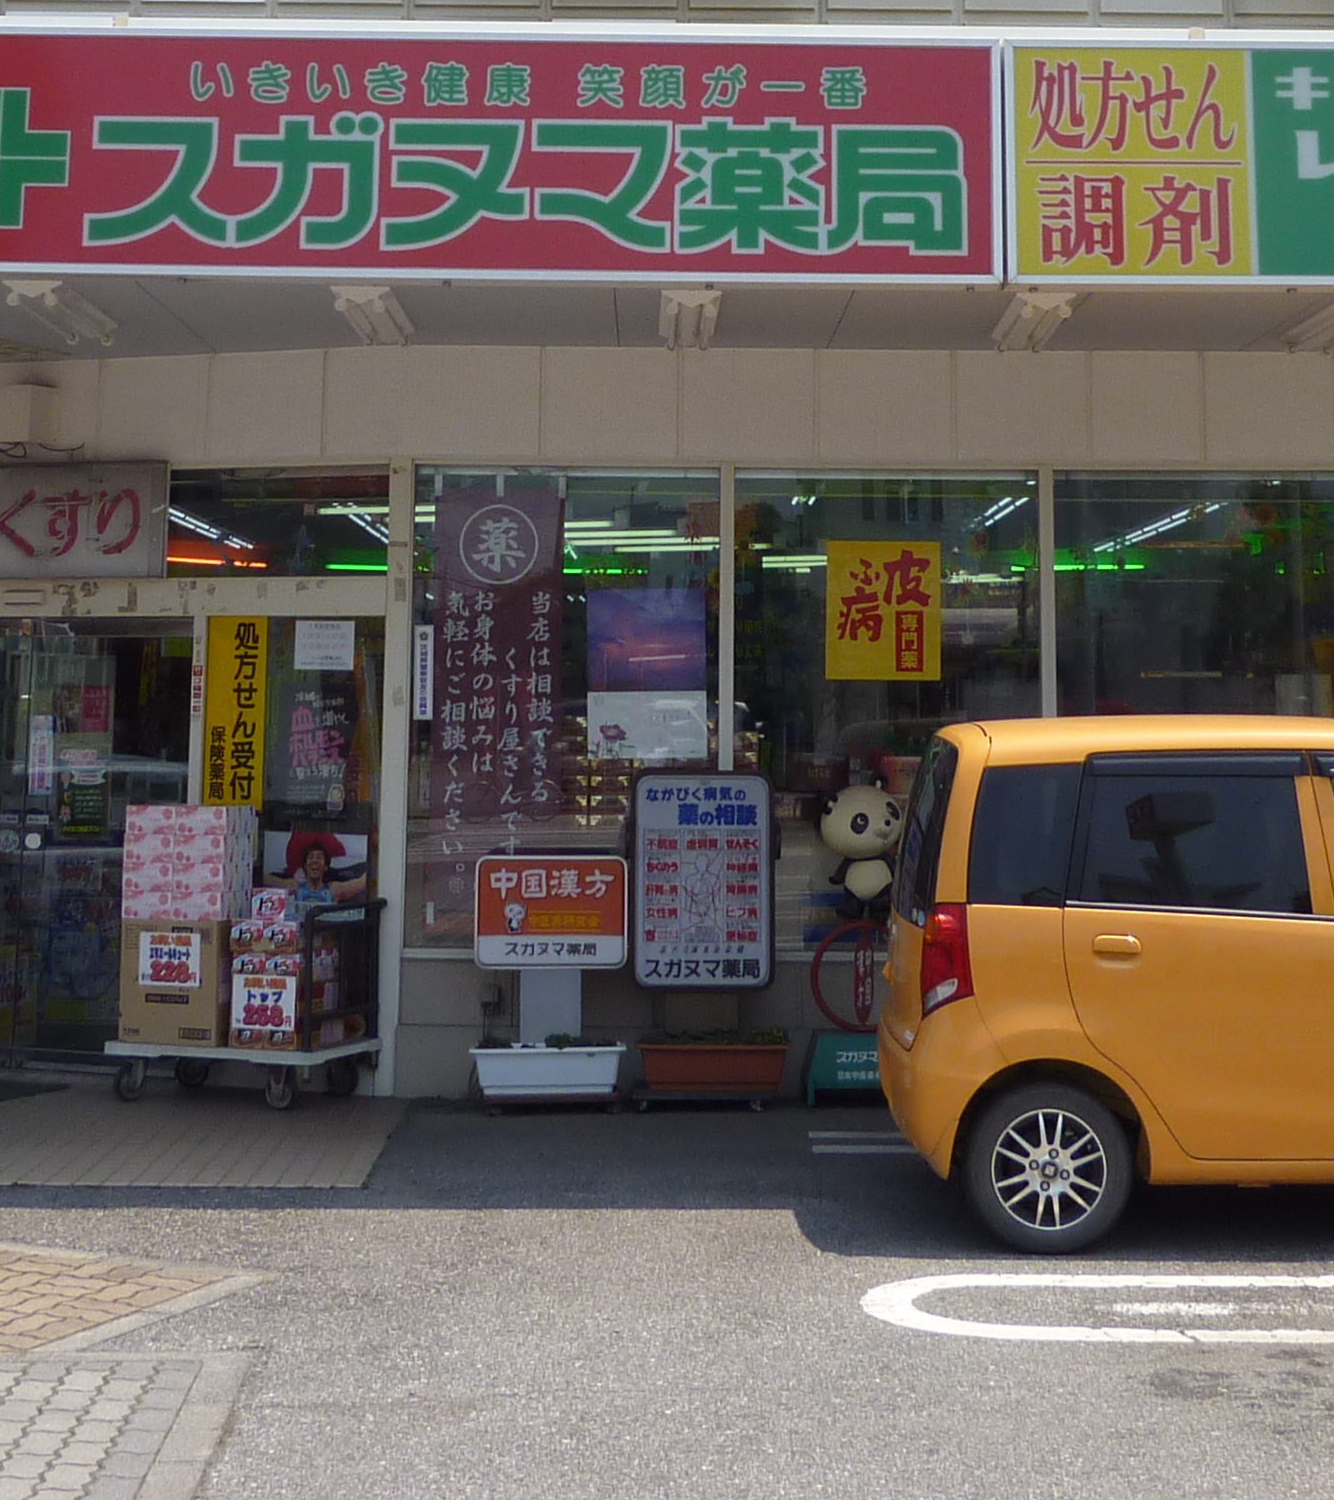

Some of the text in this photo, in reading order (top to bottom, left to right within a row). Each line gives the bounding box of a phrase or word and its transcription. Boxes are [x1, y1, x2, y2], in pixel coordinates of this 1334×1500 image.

[190, 60, 869, 109] いきいき健康 笑顔が一番
[1028, 58, 1237, 154] 処方せん
[83, 111, 970, 256] スガヌマ薬局
[1035, 172, 1235, 269] 調剤
[471, 517, 525, 574] 薬
[900, 614, 919, 669] 専門薬
[229, 622, 259, 801] 処方せん受付
[469, 591, 494, 773] お身体の悩みは
[526, 592, 554, 802] 当店は相談できる
[208, 726, 226, 800] 保険薬局
[497, 648, 522, 856] くすり屋さんです
[645, 787, 746, 802] ながびく病気の
[678, 803, 757, 826] 薬の相談
[489, 867, 615, 900] 中国漢方
[505, 942, 597, 957] スガヌマ薬局
[645, 959, 760, 979] スガヌマ薬局
